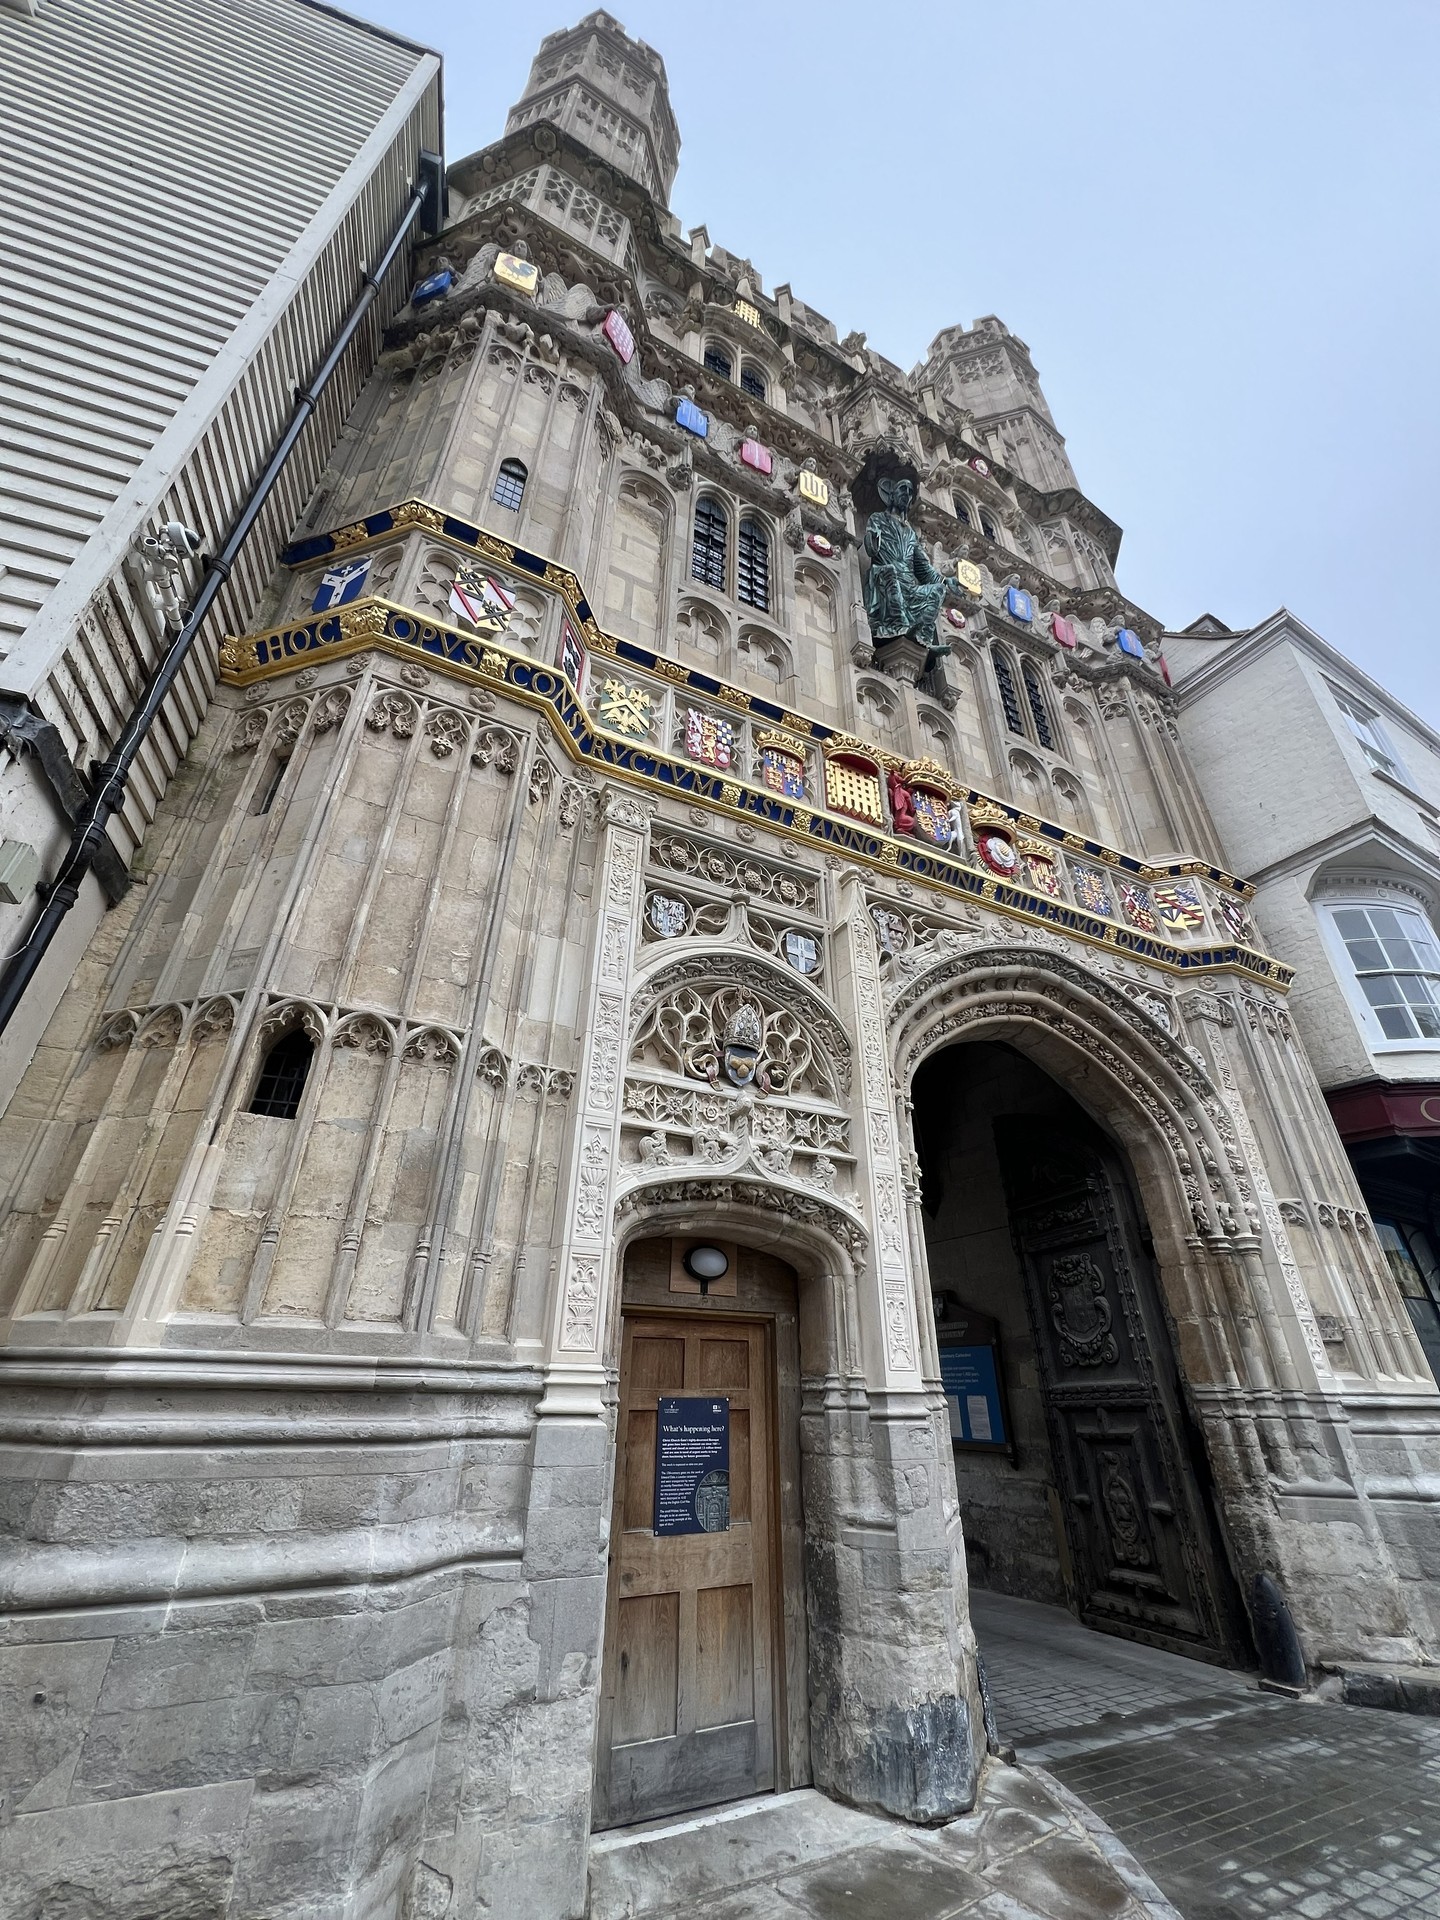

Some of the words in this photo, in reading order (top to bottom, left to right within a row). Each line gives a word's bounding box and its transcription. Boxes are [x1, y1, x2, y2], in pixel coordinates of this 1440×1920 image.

[265, 617, 336, 664] HOC
[388, 614, 482, 668] OPVS
[508, 662, 714, 799] CONSTRVCTVM
[742, 791, 794, 824] EST
[809, 819, 881, 858] ANNO
[899, 850, 982, 894] DOMINI
[1000, 887, 1102, 937] MILLESIMO
[683, 1425, 710, 1434] happening
